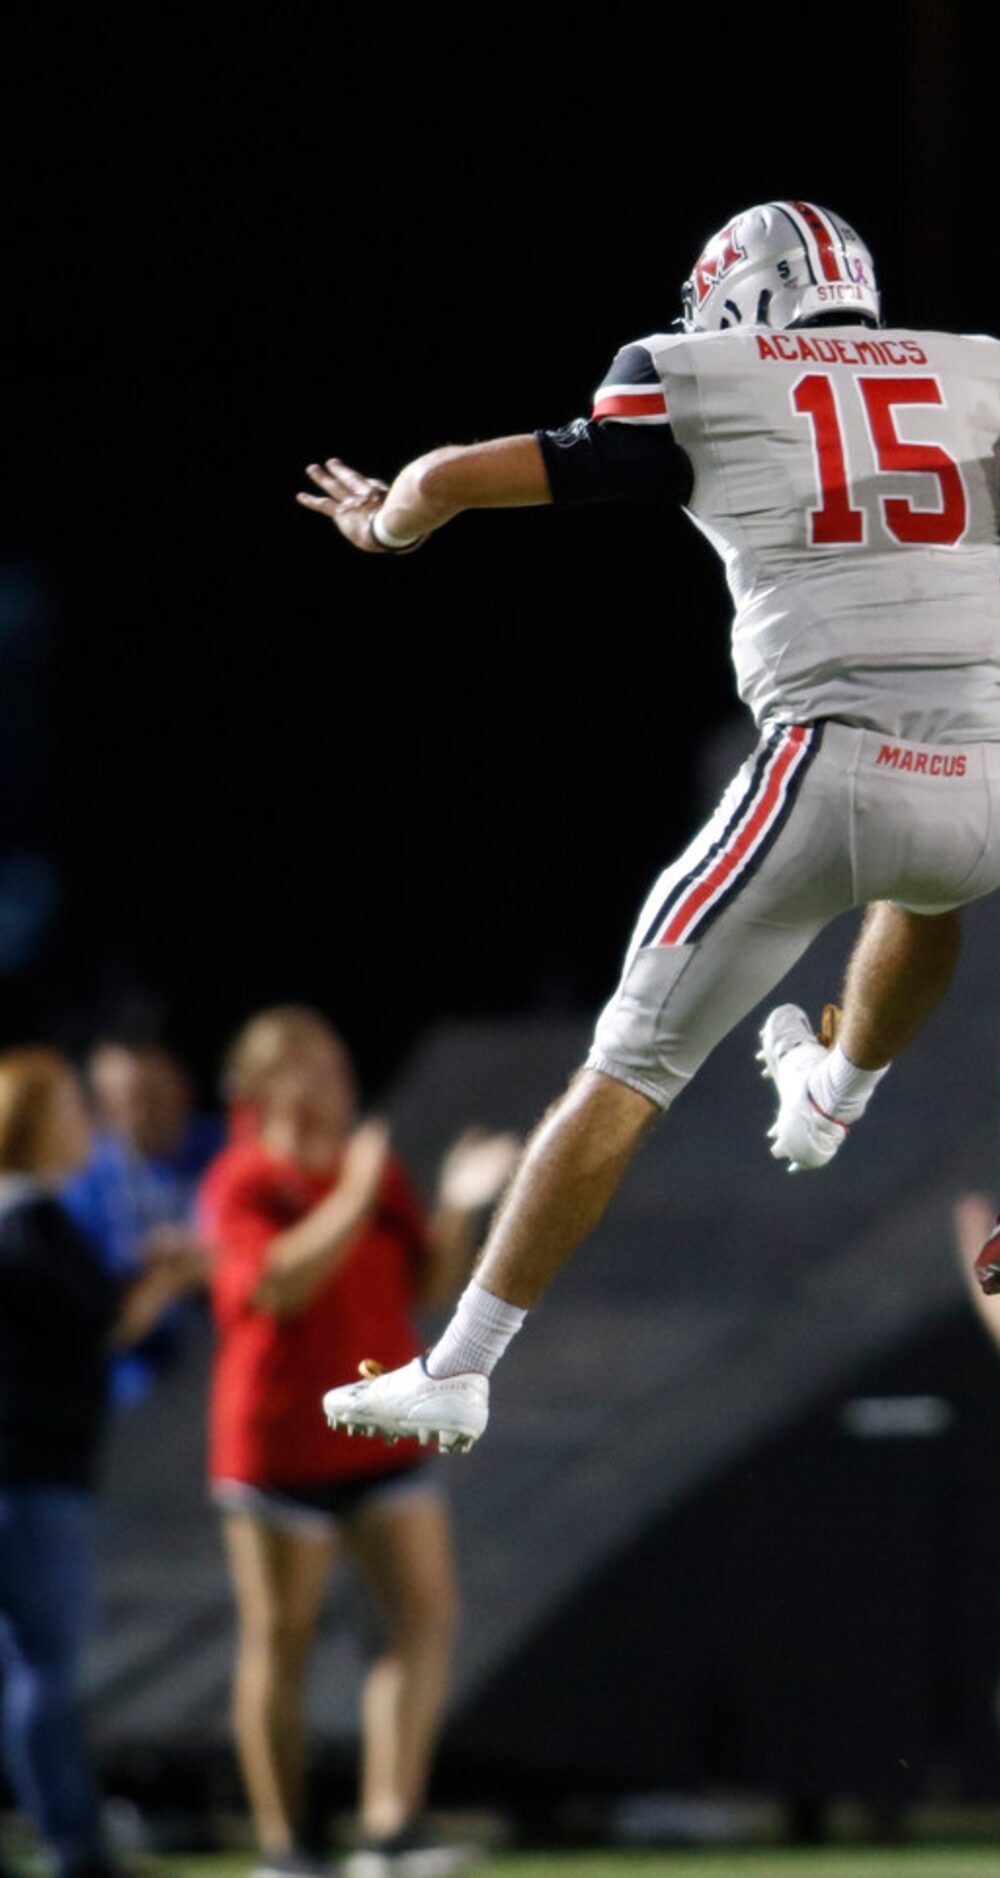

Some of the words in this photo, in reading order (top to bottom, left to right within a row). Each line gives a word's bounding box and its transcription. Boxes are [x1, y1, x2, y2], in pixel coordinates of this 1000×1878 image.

[755, 335, 928, 366] ACADEMICS
[790, 371, 970, 547] 15
[875, 744, 968, 777] MARCUS
